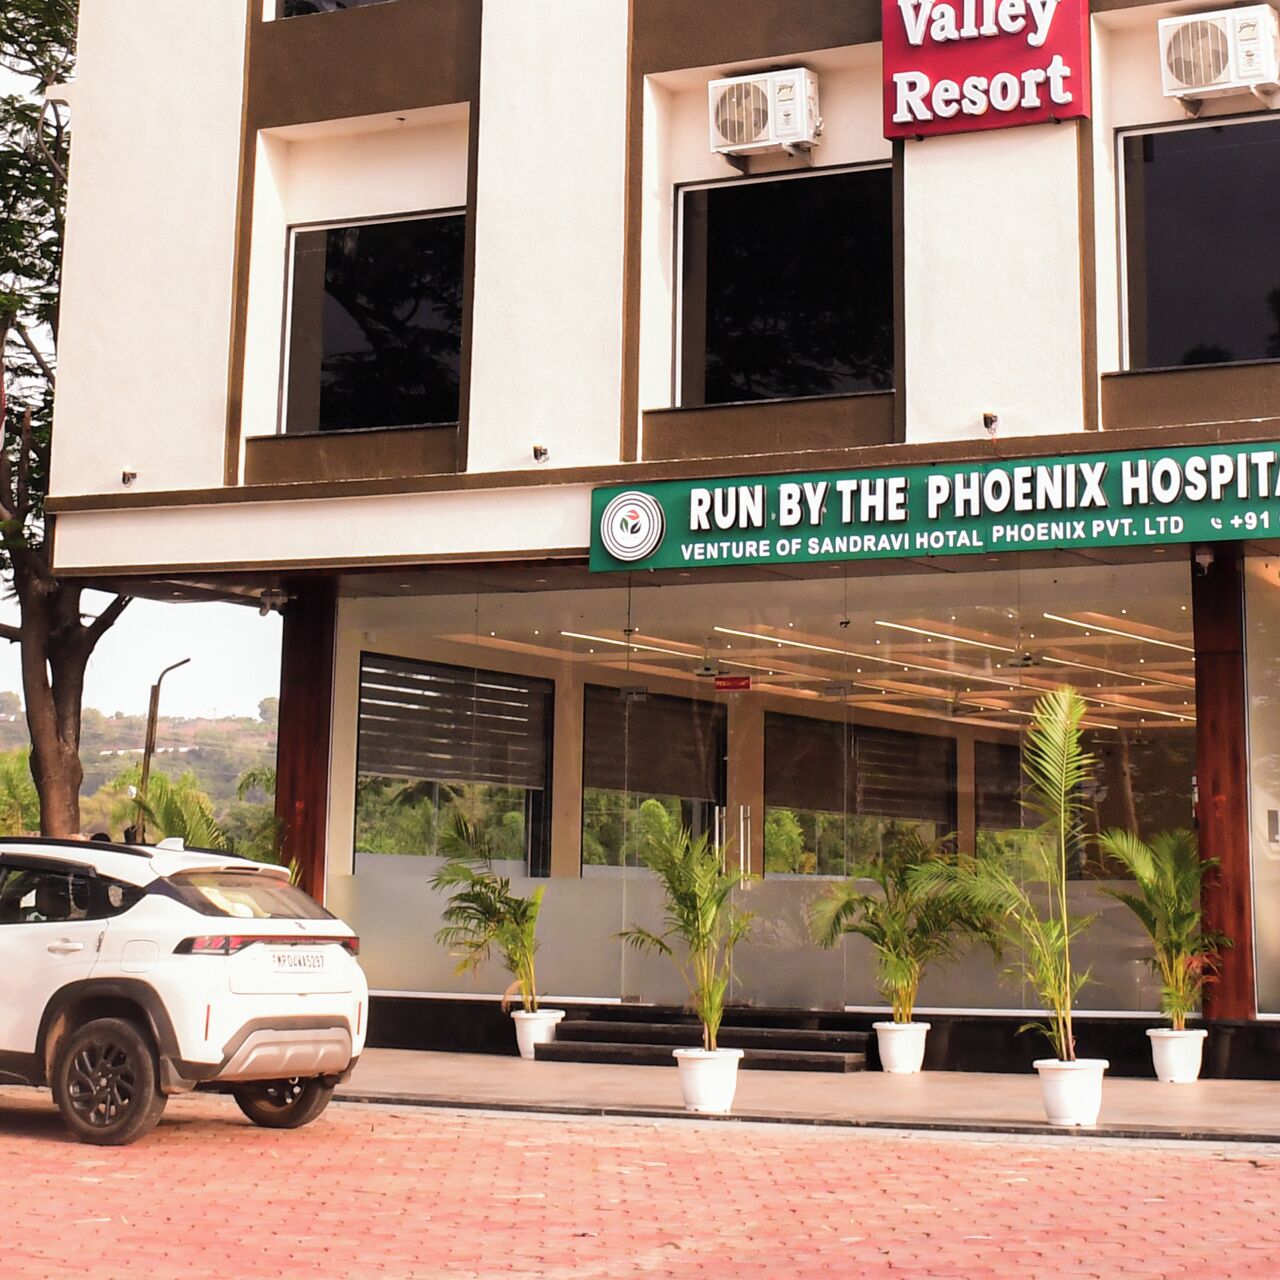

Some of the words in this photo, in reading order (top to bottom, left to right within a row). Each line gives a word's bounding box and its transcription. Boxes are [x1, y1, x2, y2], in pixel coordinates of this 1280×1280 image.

[892, 55, 1073, 123] Resort
[689, 484, 766, 531] RUN
[778, 481, 829, 527] BY
[836, 477, 908, 523] THE
[927, 461, 1108, 519] PHOENIX
[681, 538, 770, 561] VENTURE
[775, 535, 802, 556] OF
[807, 532, 910, 555] SANDRAVI
[915, 529, 984, 550] HOTAL
[992, 520, 1084, 543] PHOENIX
[1092, 517, 1138, 539] PVT.
[1144, 515, 1184, 535] LTD
[1229, 510, 1270, 530] +91
